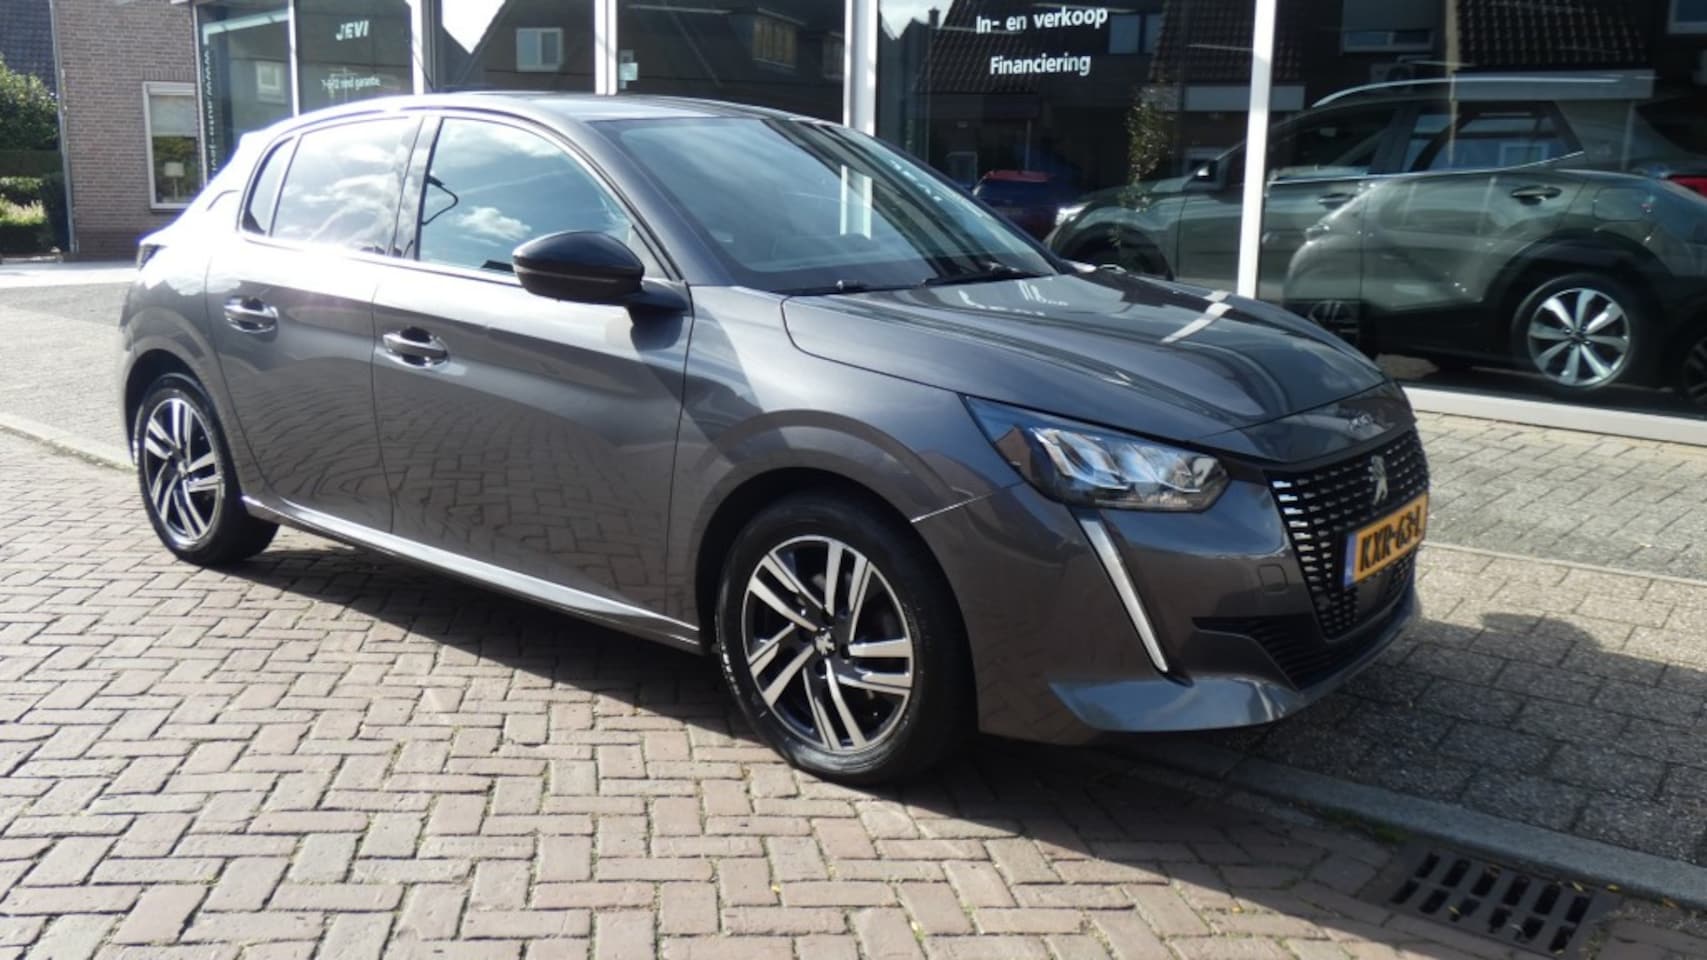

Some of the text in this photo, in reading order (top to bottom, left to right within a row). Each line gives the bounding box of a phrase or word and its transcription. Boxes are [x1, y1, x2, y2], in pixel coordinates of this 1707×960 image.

[336, 20, 370, 41] JEVI
[976, 5, 1108, 34] In- en verkoop
[990, 52, 1091, 76] Financiering
